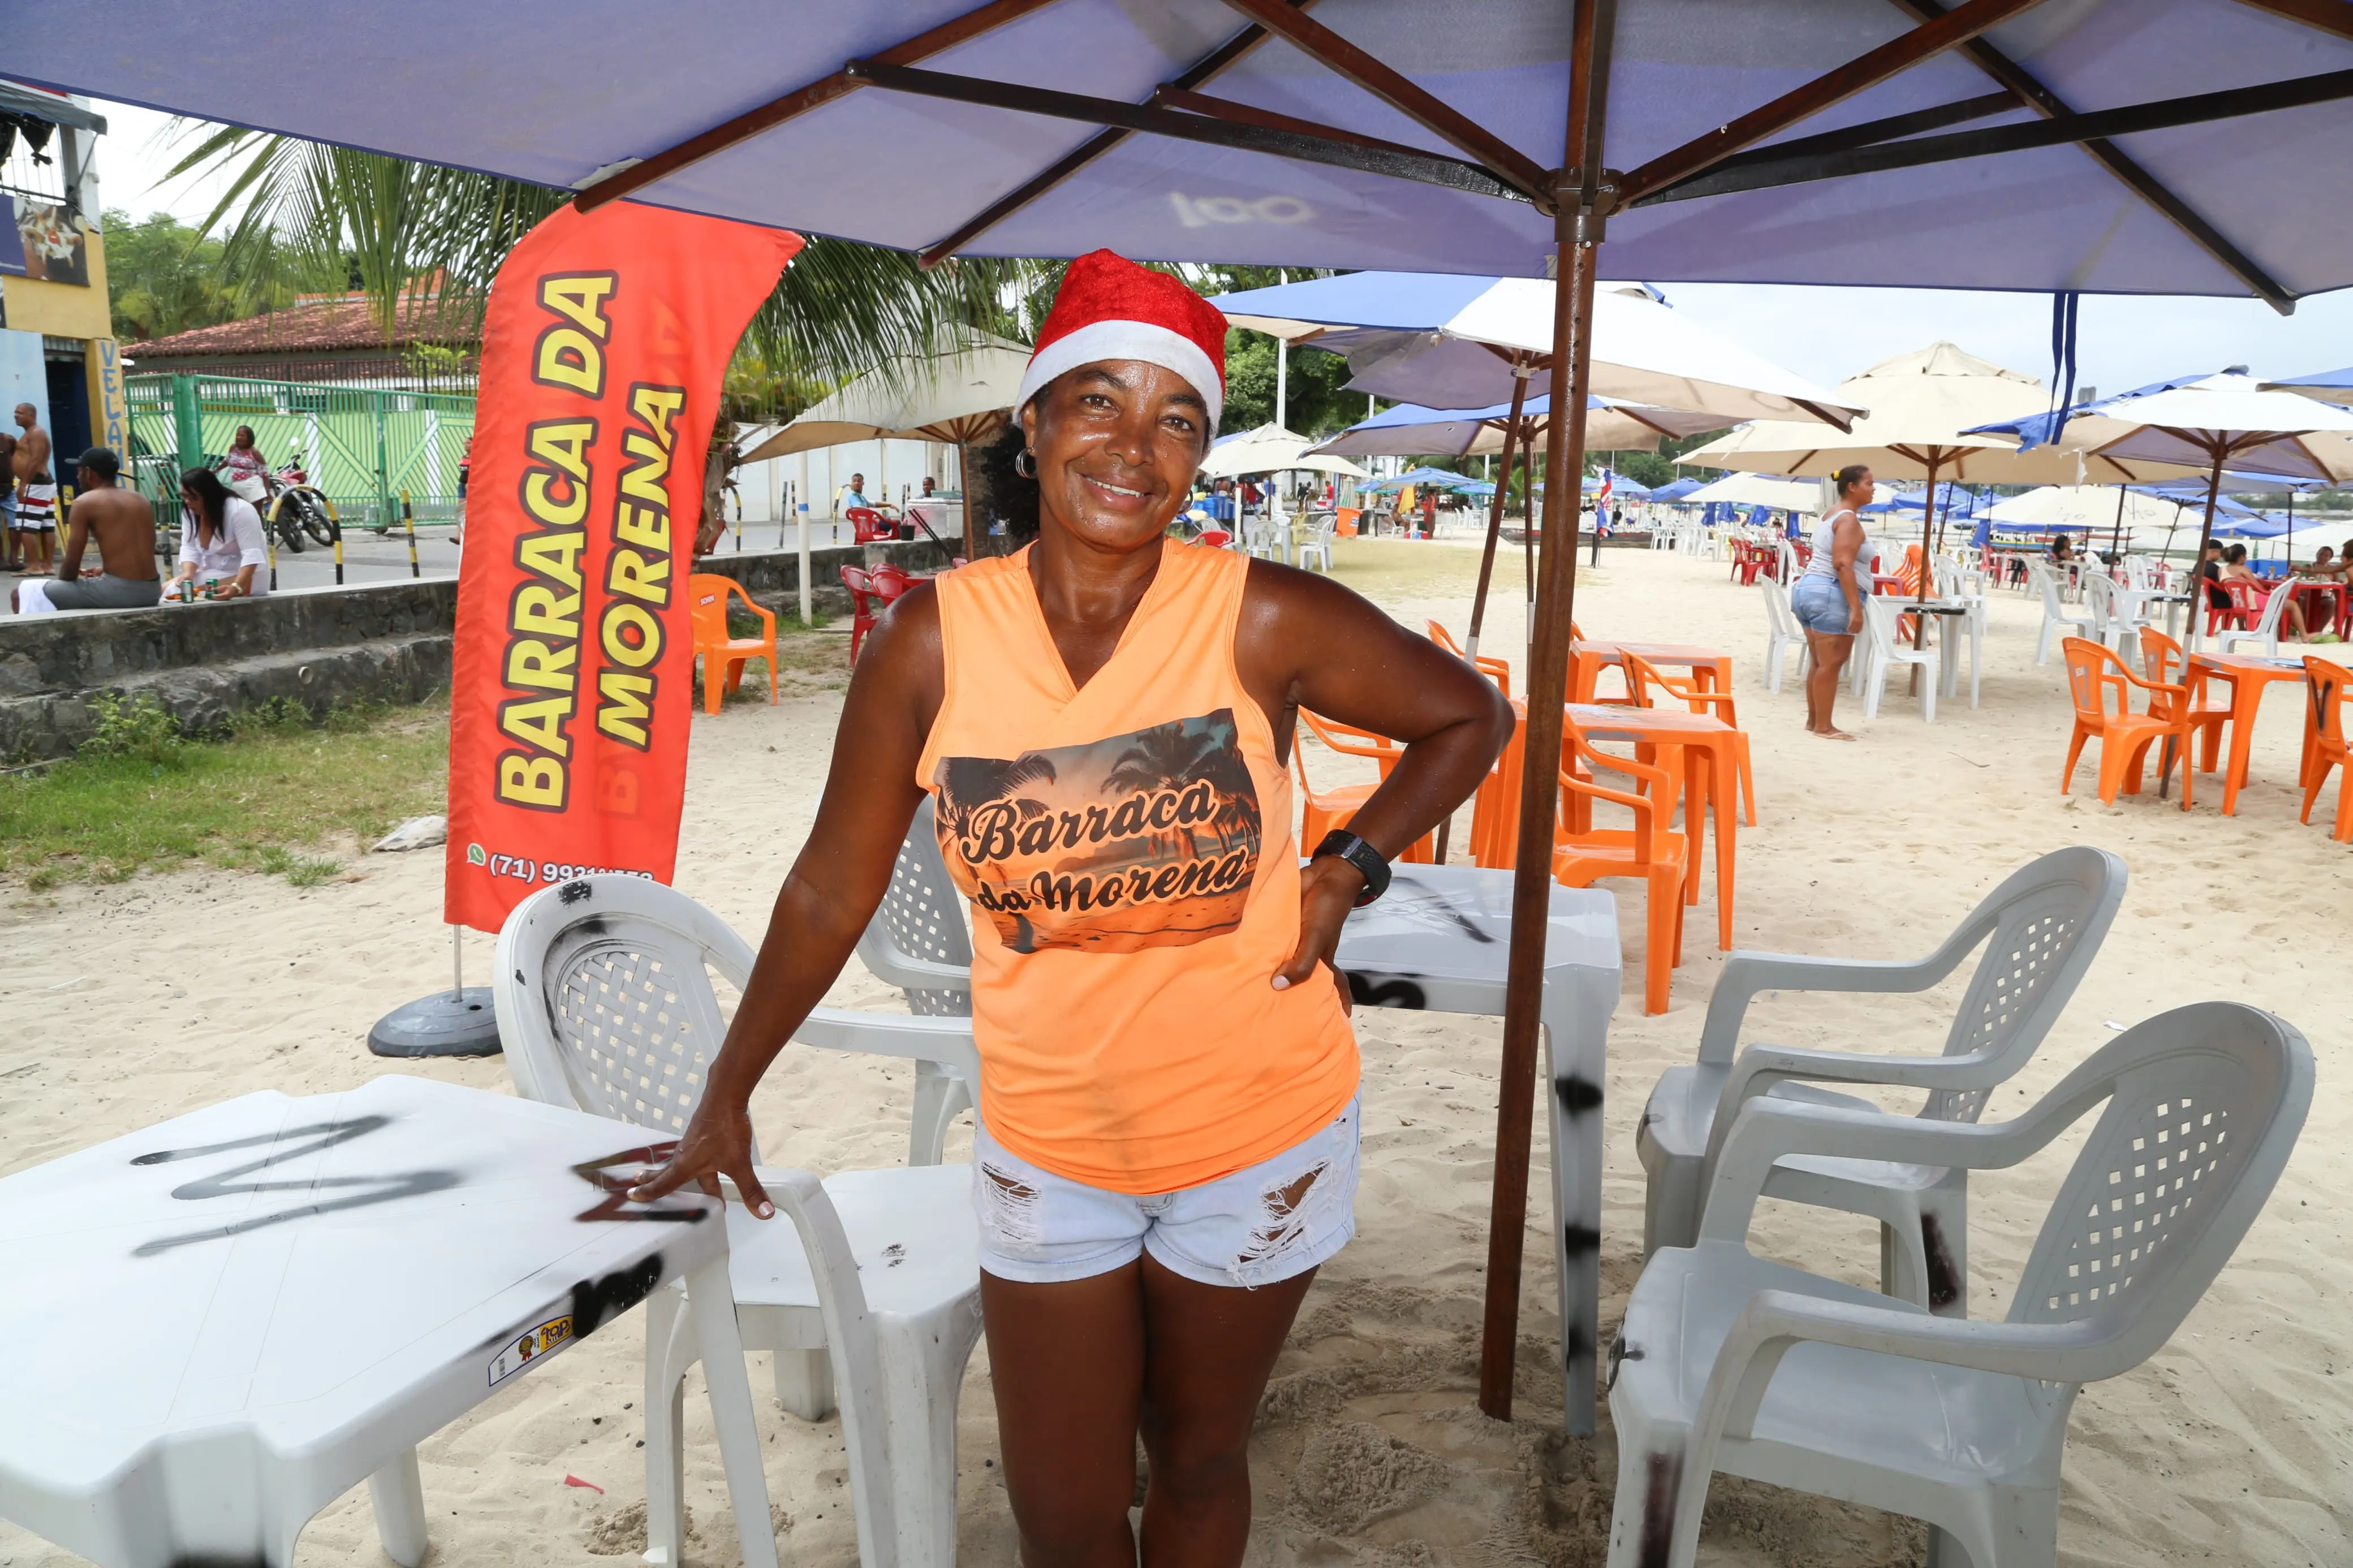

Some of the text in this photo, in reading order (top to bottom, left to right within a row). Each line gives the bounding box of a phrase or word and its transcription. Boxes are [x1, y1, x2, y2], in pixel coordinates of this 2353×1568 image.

[495, 272, 617, 810] BARRACA DA
[596, 383, 686, 750] MORENA
[960, 780, 1219, 865] Barraca
[489, 852, 537, 884] (71)
[976, 848, 1249, 912] da Morena
